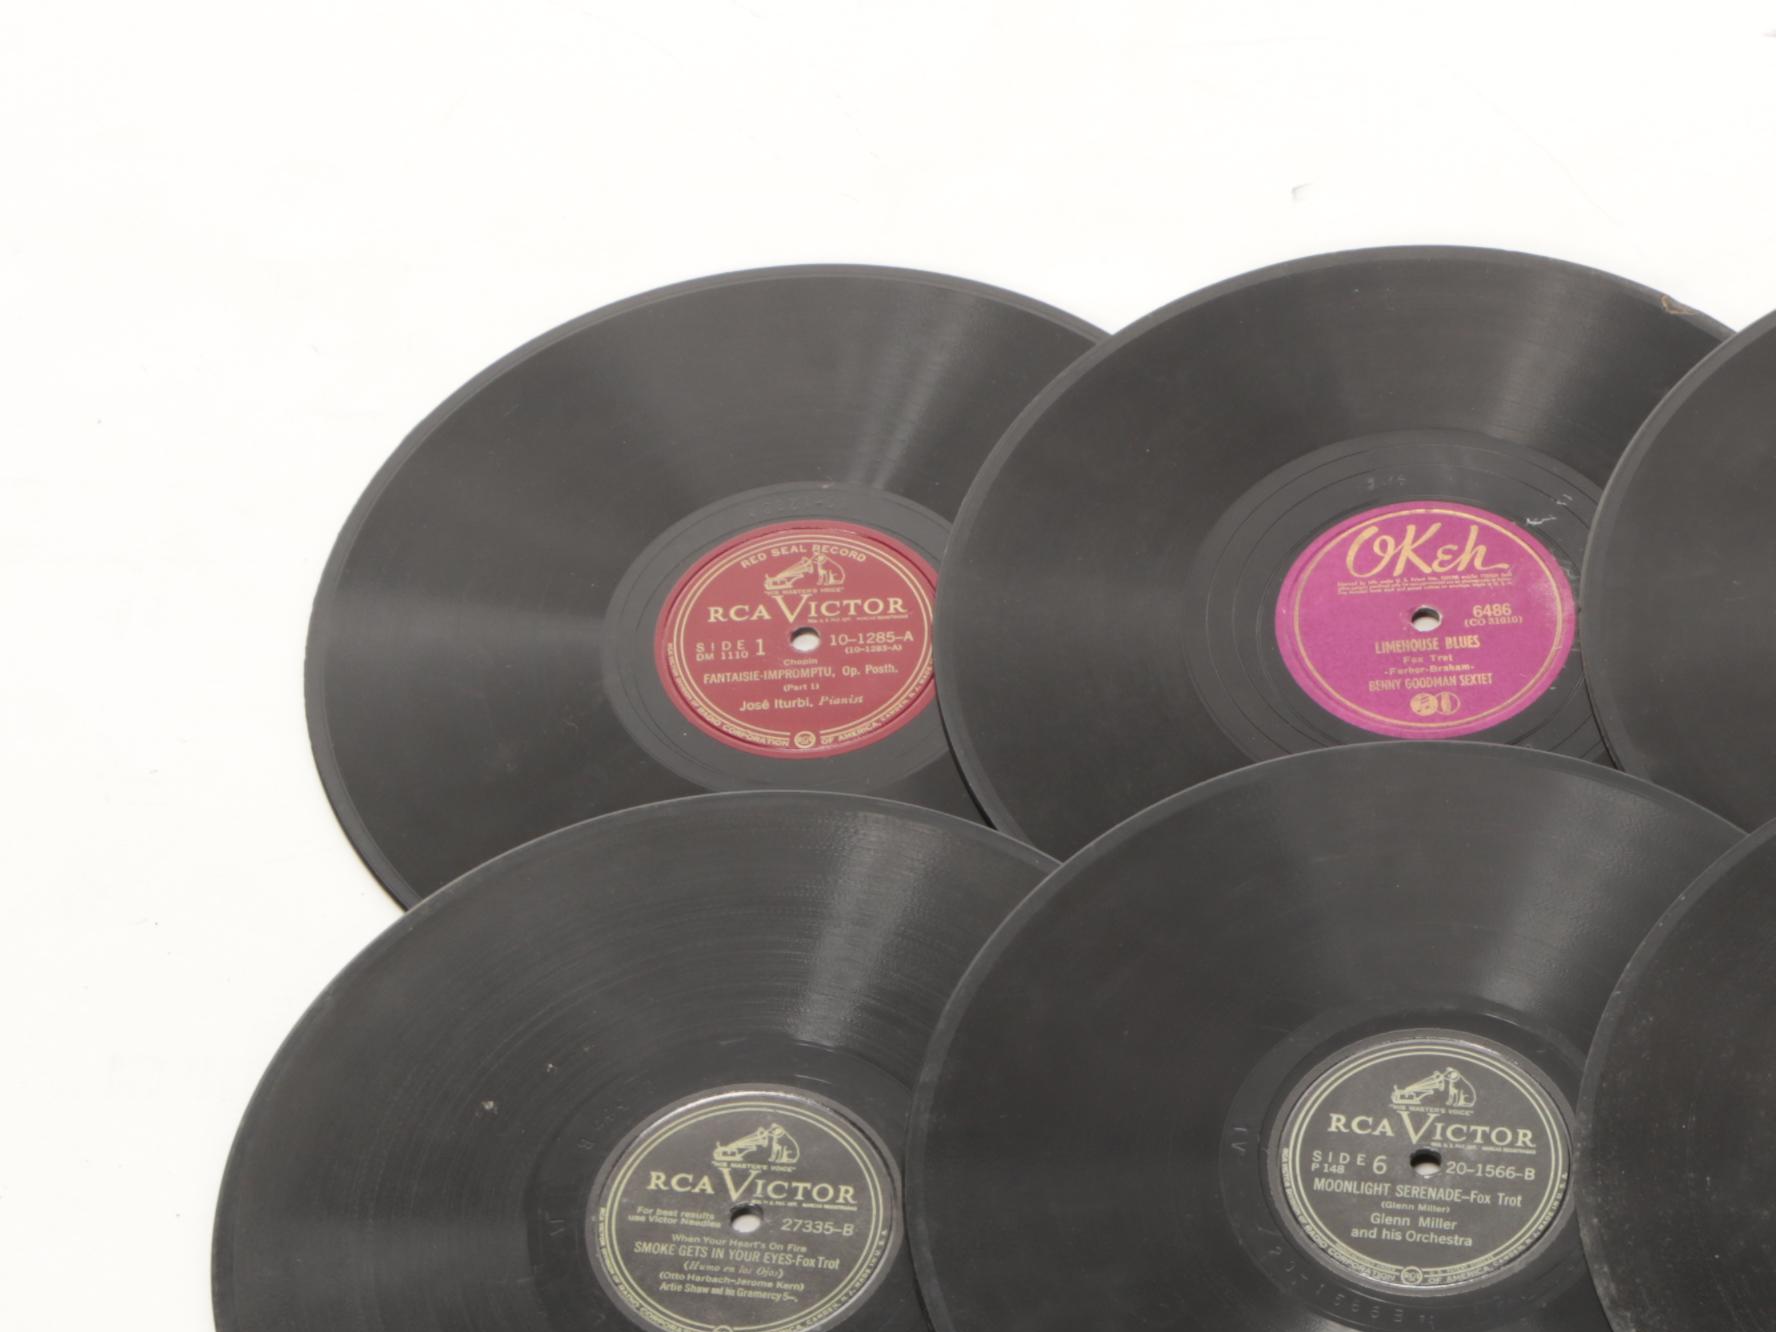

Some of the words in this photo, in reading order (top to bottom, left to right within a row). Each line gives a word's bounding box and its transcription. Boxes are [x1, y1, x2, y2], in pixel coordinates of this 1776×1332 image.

[740, 552, 767, 569] RED
[771, 545, 807, 557] SEAL
[812, 544, 866, 563] RECORD
[707, 603, 771, 623] RCA
[771, 594, 907, 623] VICTOR
[1473, 603, 1512, 618] 6486
[1375, 638, 1439, 654] LIMEHOUSE
[1445, 635, 1480, 649] BLUES
[1369, 679, 1400, 691] BENNY
[1405, 676, 1457, 689] GOODMAN
[1459, 673, 1493, 686] SEXTET
[739, 699, 770, 712] José
[1328, 1113, 1394, 1136] RCA
[1398, 1111, 1536, 1147] VICTOR
[1312, 1151, 1365, 1166] SIDE
[1373, 1155, 1387, 1174] 6
[1446, 1162, 1535, 1181] 20-1566-B
[646, 1171, 714, 1195] RCA
[718, 1167, 857, 1204] VICTOR
[1314, 1178, 1391, 1196] MOONLIGHT
[1497, 1193, 1522, 1207] Trot
[781, 1218, 854, 1236] 27335-B
[1370, 1213, 1410, 1226] Glenn
[1419, 1216, 1457, 1230] Miller
[1351, 1227, 1377, 1239] and
[1382, 1228, 1402, 1241] his
[1405, 1231, 1472, 1247] Orchestra
[634, 1241, 675, 1255] SMOKE
[679, 1245, 708, 1258] GETS
[711, 1248, 724, 1258] IN
[729, 1249, 760, 1262] YOUR
[818, 1258, 839, 1270] Trot
